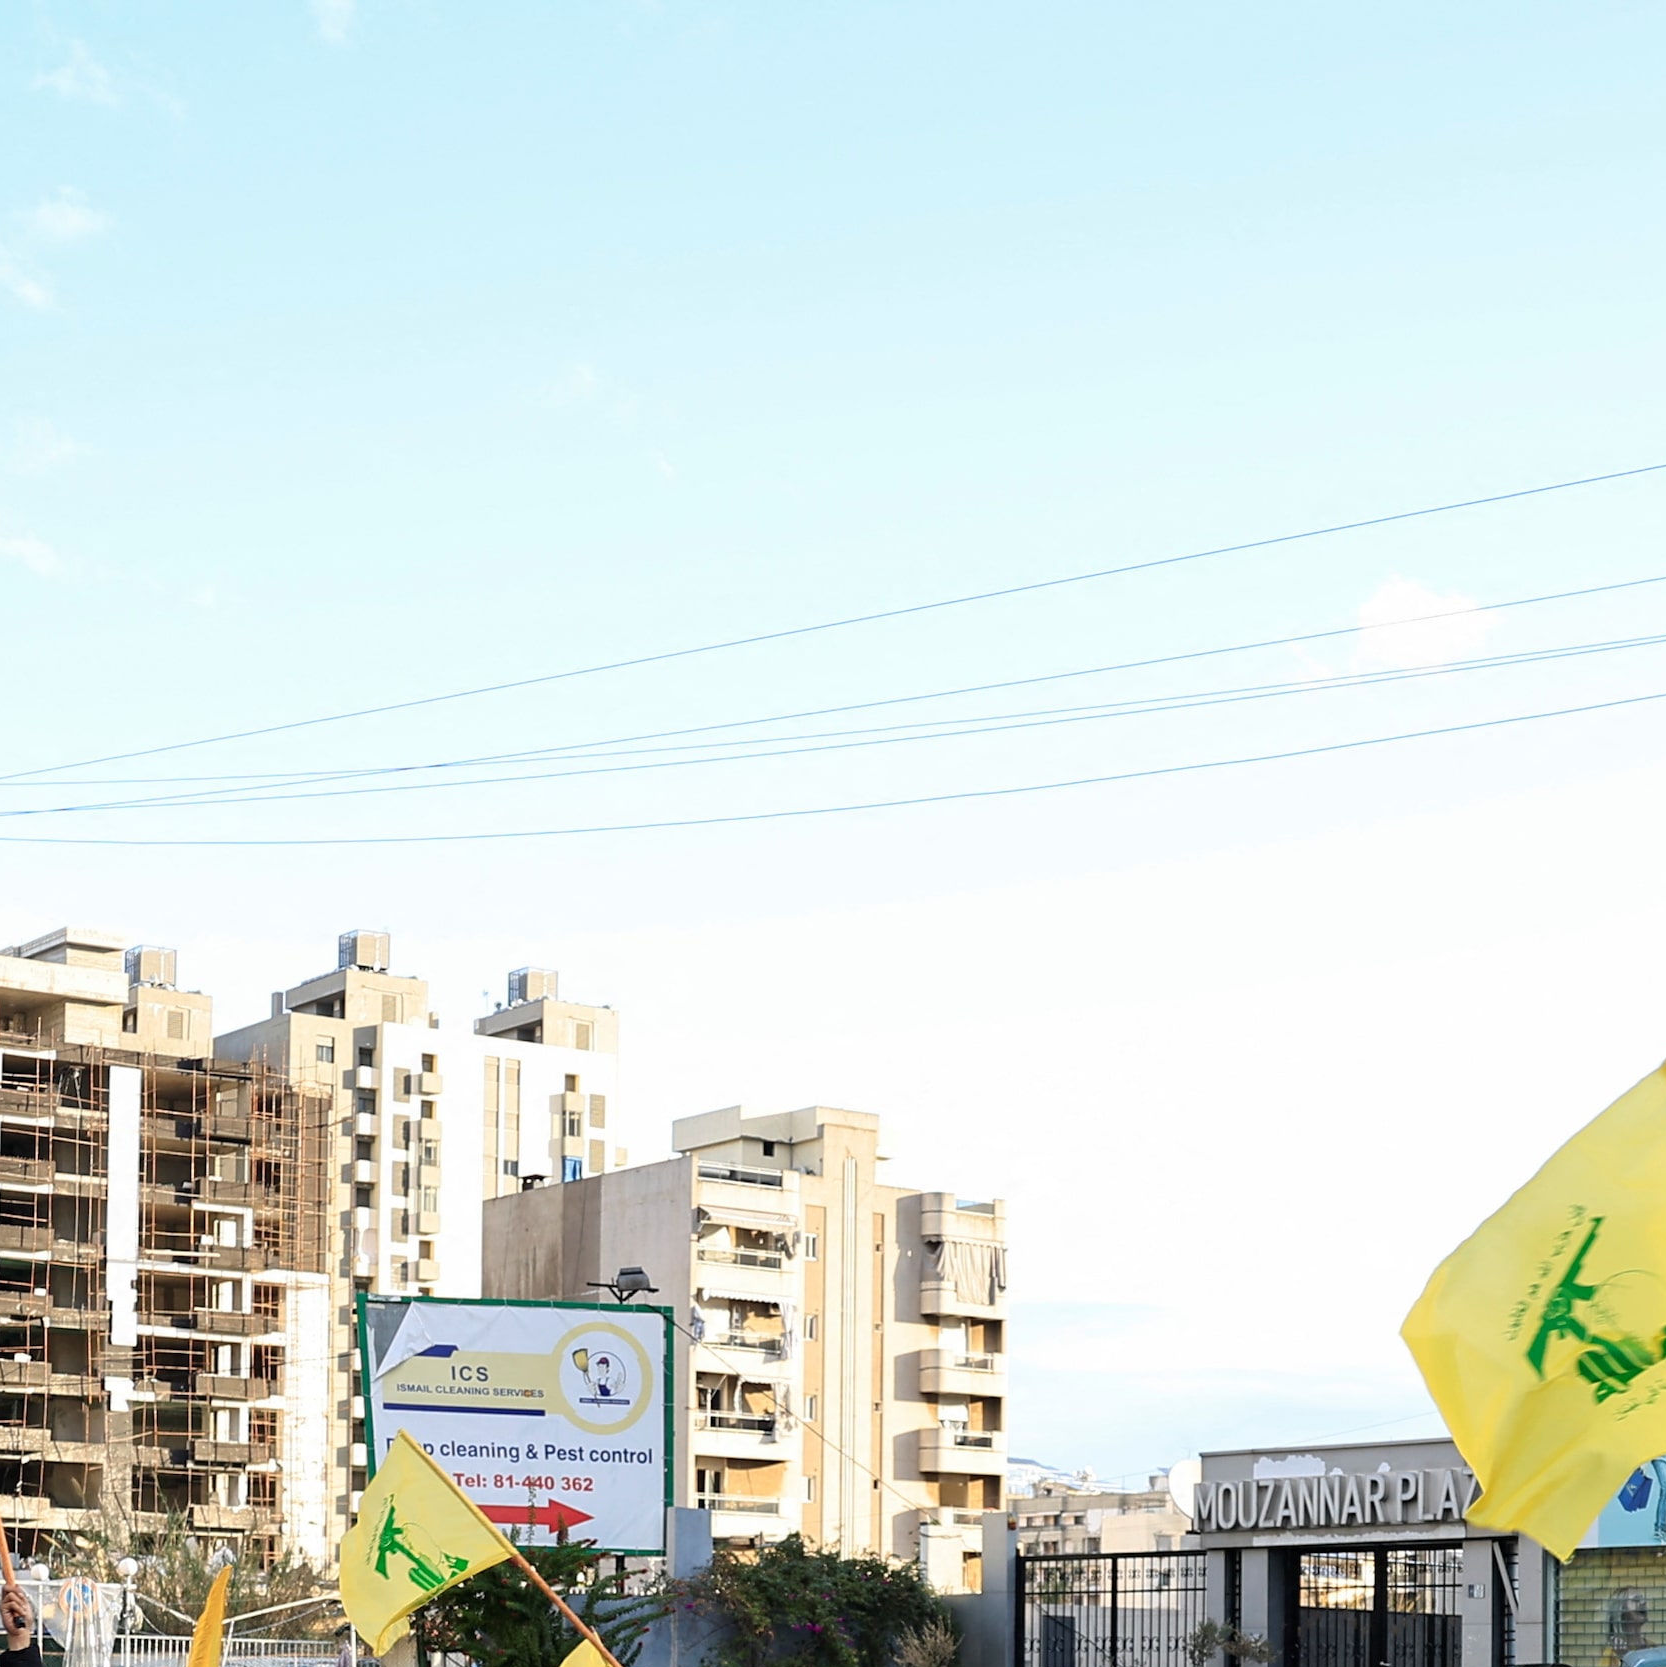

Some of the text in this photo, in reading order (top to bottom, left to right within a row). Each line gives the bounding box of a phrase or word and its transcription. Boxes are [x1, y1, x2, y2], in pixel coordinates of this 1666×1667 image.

[451, 1365, 489, 1382] ICS
[396, 1383, 544, 1399] ISMAIL CLEANING SERVICES
[440, 1441, 520, 1464] cleaning
[526, 1443, 539, 1460] &
[544, 1444, 585, 1462] Pest
[589, 1447, 653, 1464] control
[453, 1472, 594, 1492] Tel: 81-440 362
[1194, 1467, 1483, 1531] MOUZANNAR PLAZ
